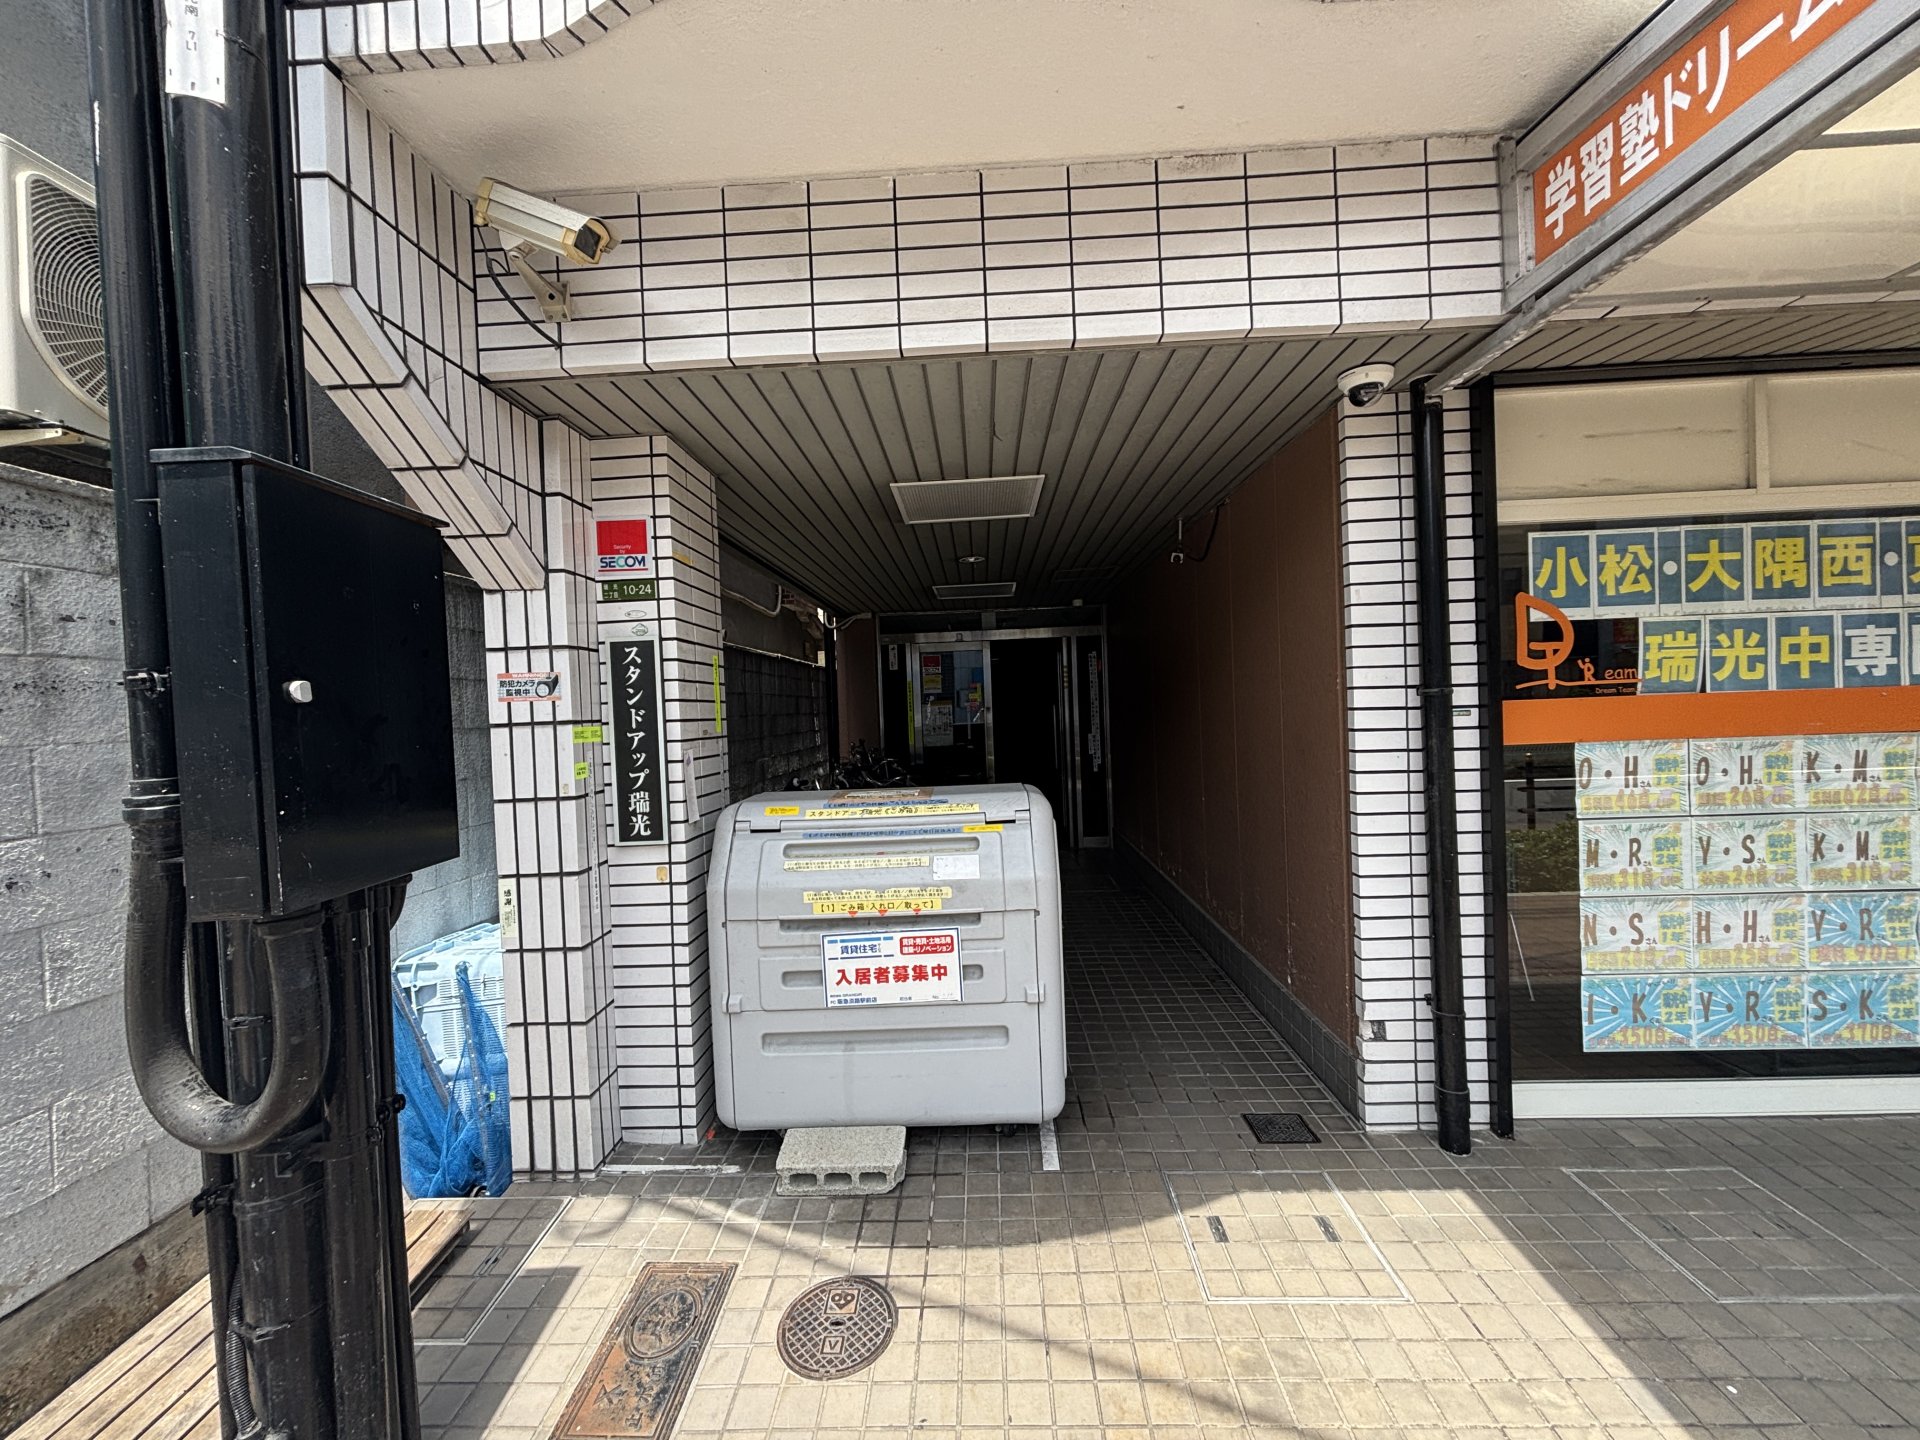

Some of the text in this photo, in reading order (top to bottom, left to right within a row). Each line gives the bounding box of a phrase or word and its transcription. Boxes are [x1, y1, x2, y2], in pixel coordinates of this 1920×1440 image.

[600, 556, 646, 568] SECOM
[1535, 534, 1920, 599] 小松・大隅西・
[623, 584, 652, 595] 10-24
[1644, 624, 1920, 684] 瑞光中専
[499, 680, 535, 688] 防犯カメラ
[506, 689, 530, 697] 監視中
[622, 646, 652, 837] スタンドアップ瑞光
[840, 943, 878, 955] 賃貸住宅
[835, 963, 948, 986] 入居者募集中
